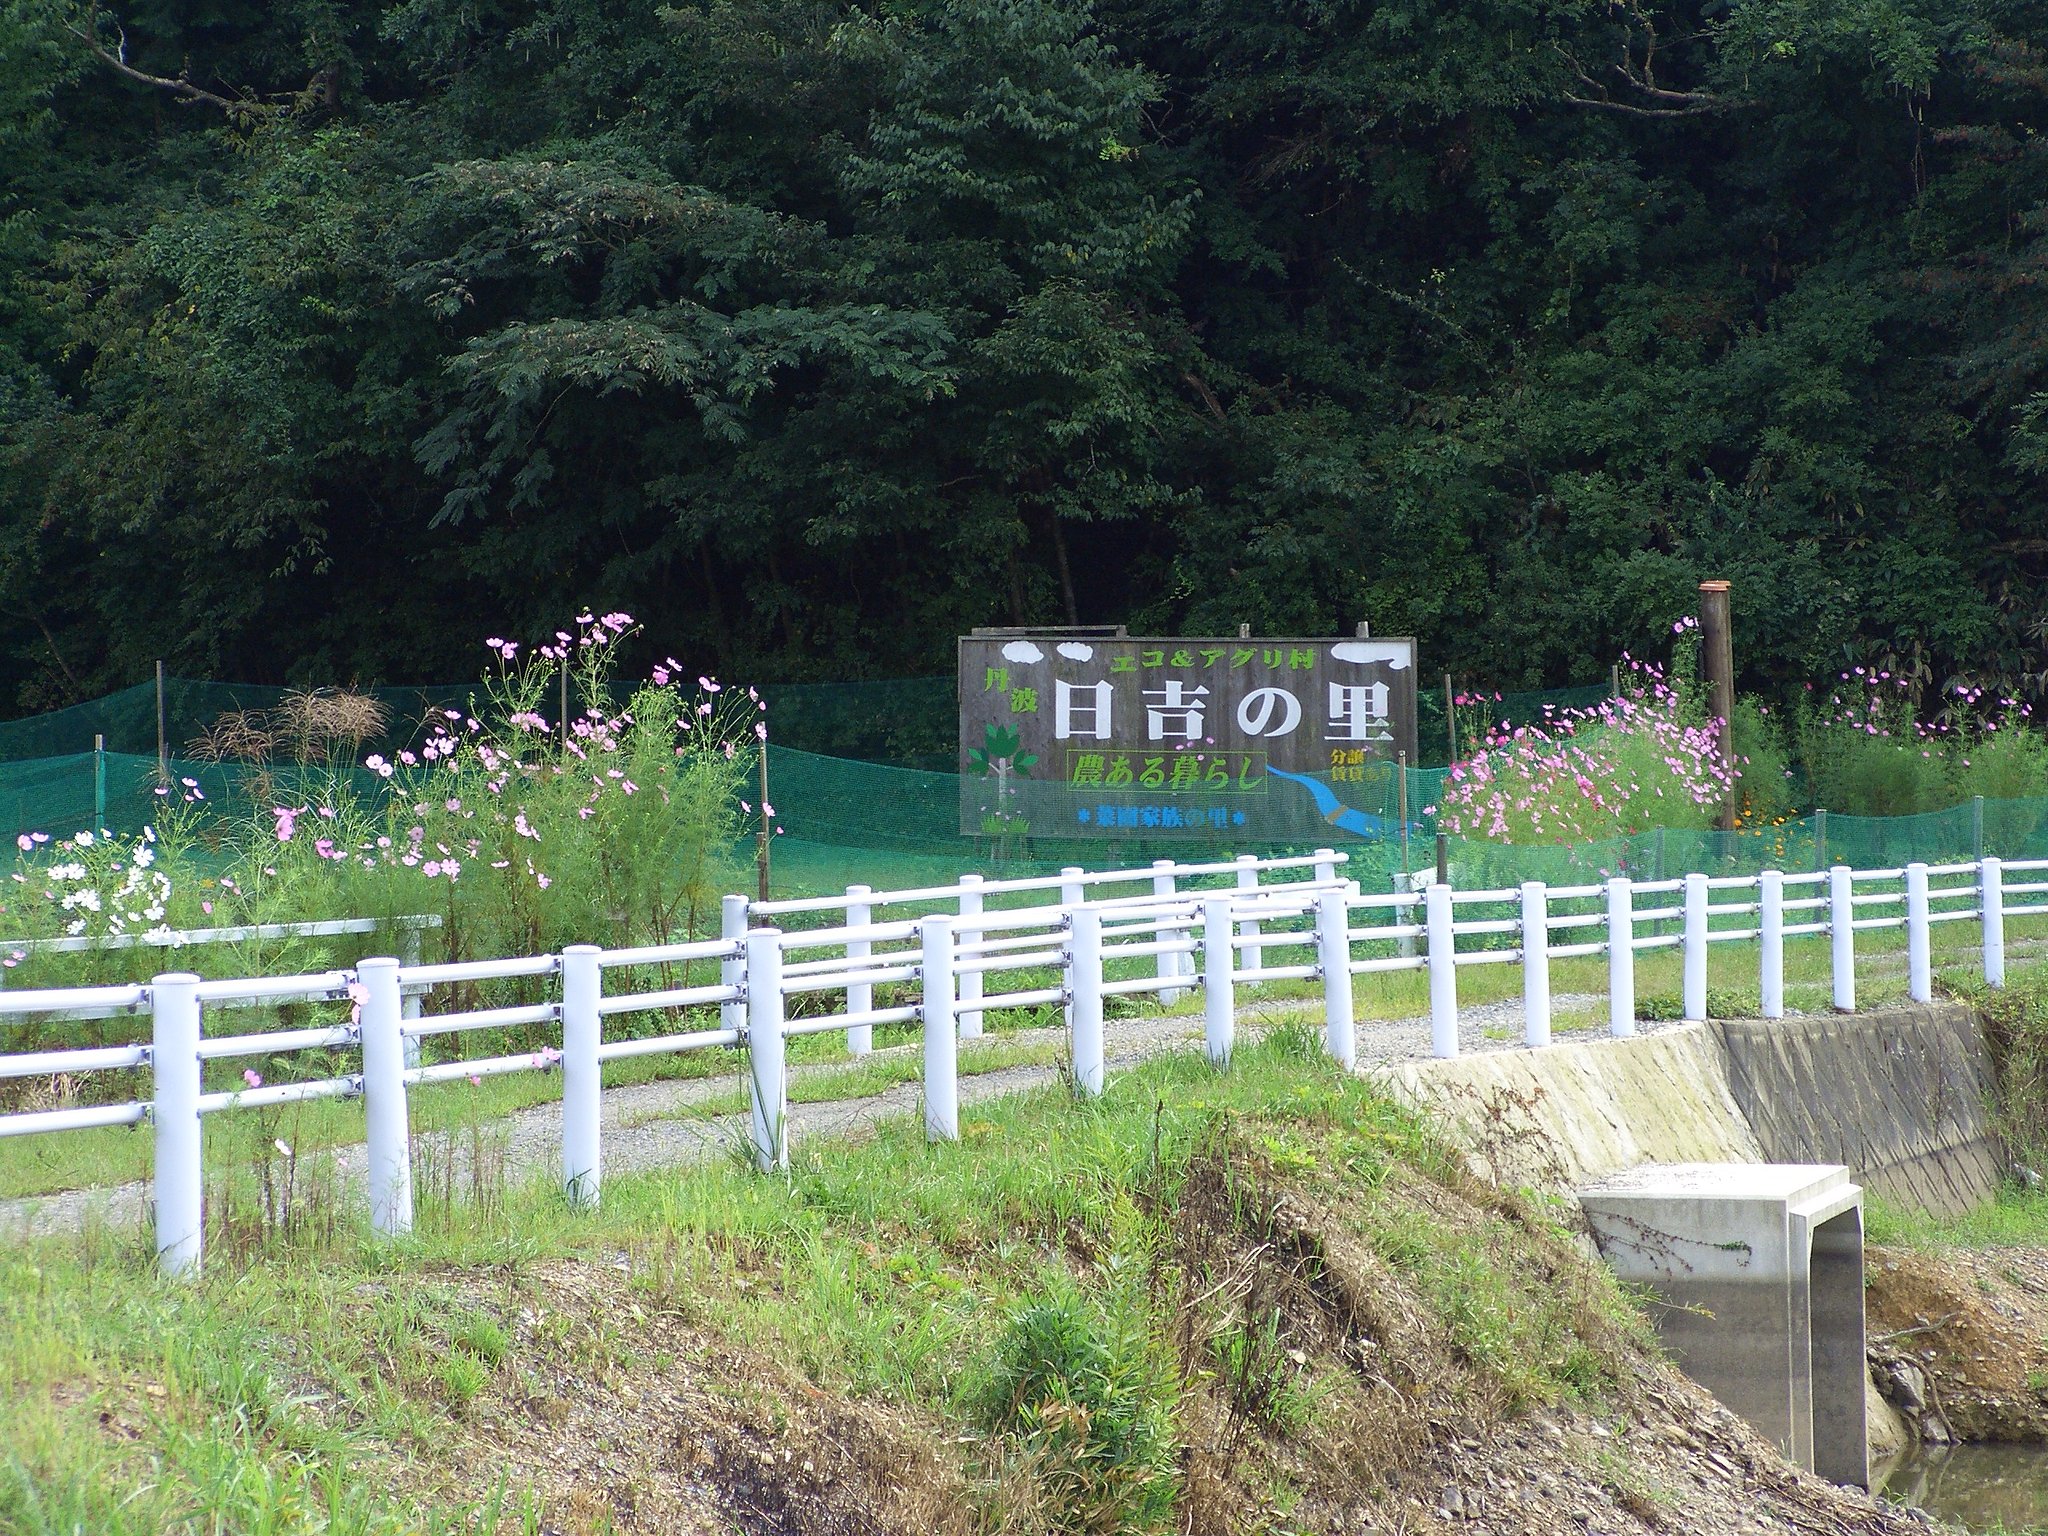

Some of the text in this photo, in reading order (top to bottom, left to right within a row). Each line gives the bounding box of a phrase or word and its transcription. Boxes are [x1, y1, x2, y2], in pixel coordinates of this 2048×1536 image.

[984, 667, 1039, 713] 丹波
[1055, 678, 1395, 741] 日吉の里
[1070, 754, 1266, 791] 農ある暮らし
